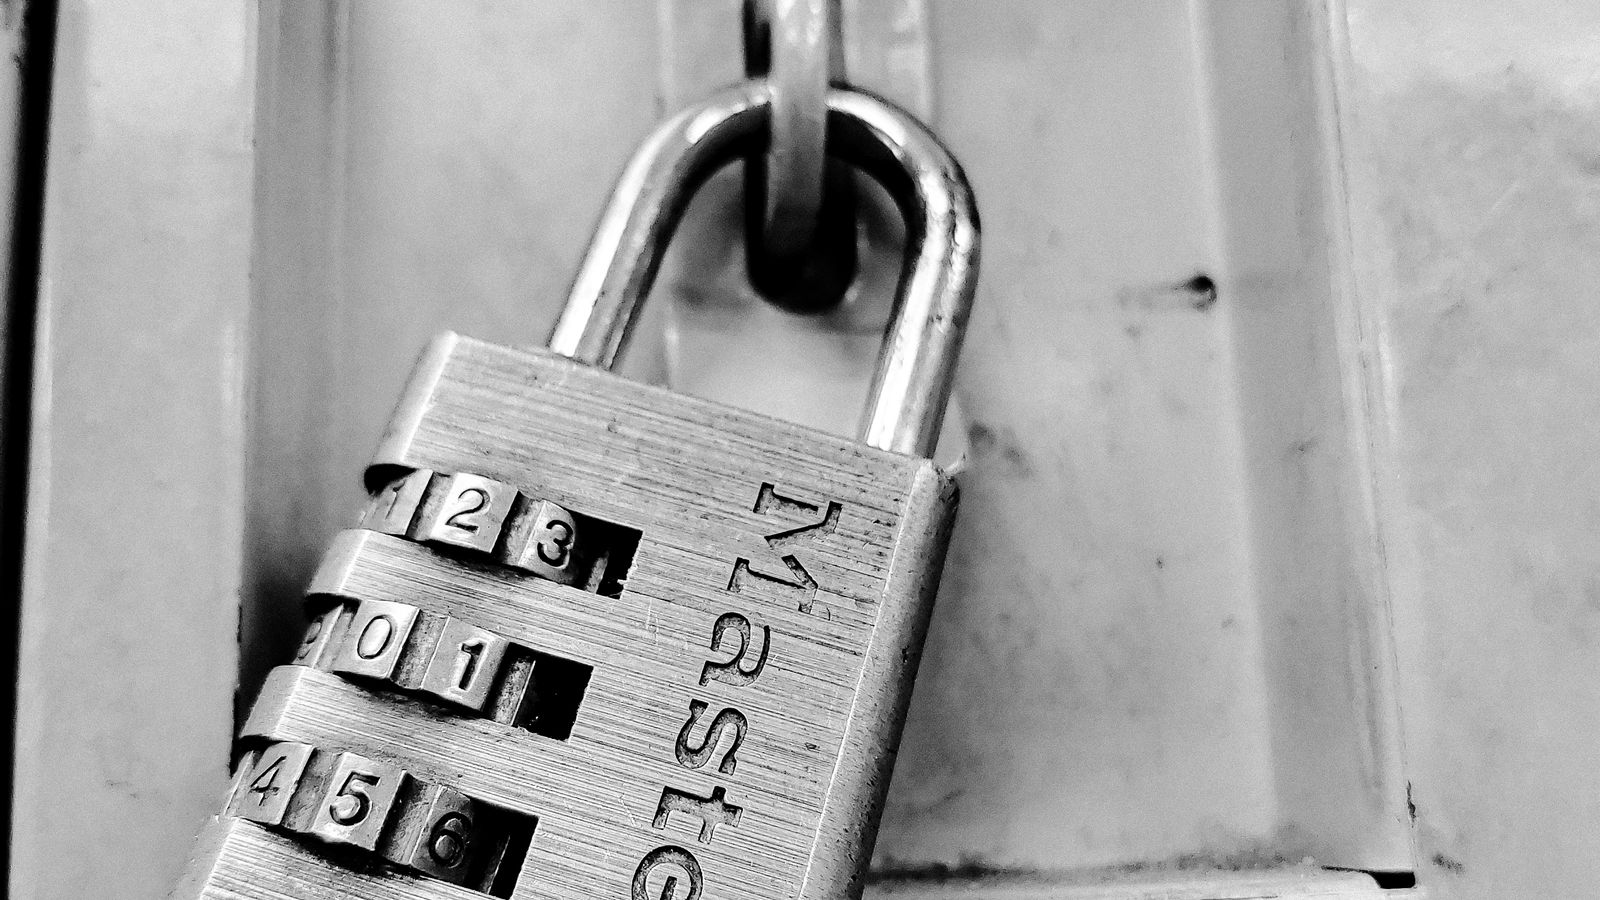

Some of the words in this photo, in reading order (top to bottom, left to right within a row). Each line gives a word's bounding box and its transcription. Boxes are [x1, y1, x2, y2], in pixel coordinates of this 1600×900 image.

[445, 487, 490, 533] 2
[537, 519, 575, 568] 3
[357, 614, 394, 660] 0
[458, 641, 488, 692] 1
[631, 482, 843, 900] Maste
[249, 755, 287, 807] 4
[329, 771, 381, 827] 5
[428, 811, 472, 869] 6
